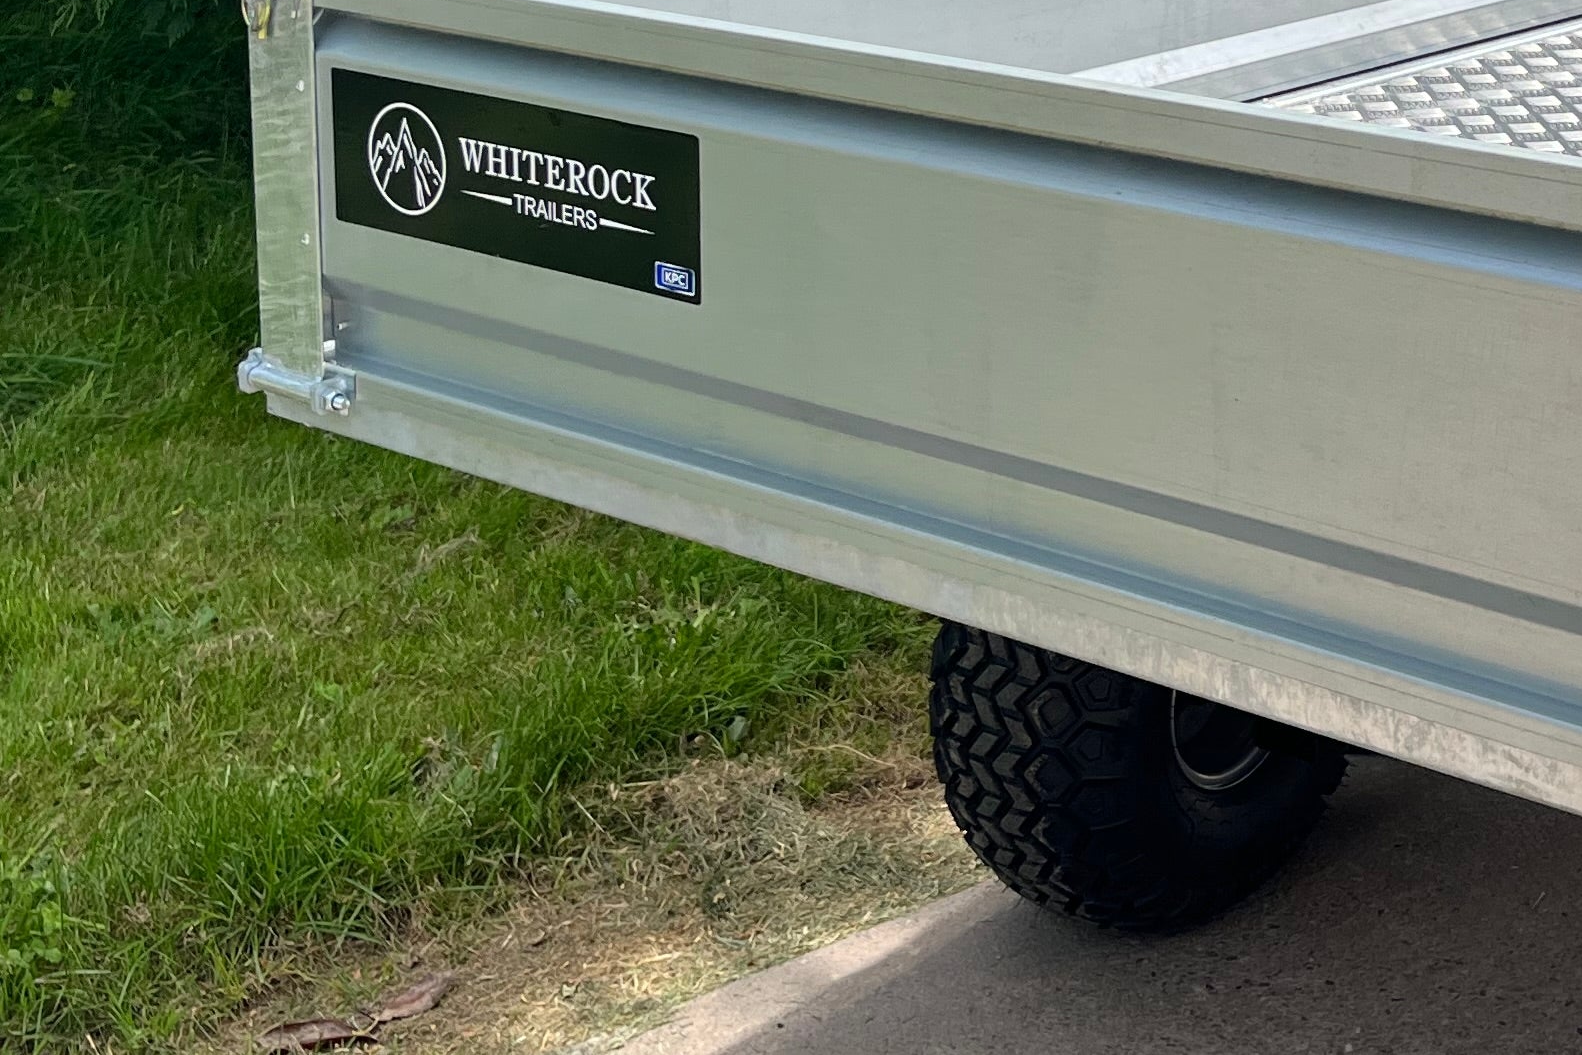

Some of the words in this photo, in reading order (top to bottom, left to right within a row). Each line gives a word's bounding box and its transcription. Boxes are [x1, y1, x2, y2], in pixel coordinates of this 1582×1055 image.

[458, 137, 657, 211] WHITEROCK
[513, 193, 598, 231] TRAILERS
[665, 271, 686, 286] KPC
